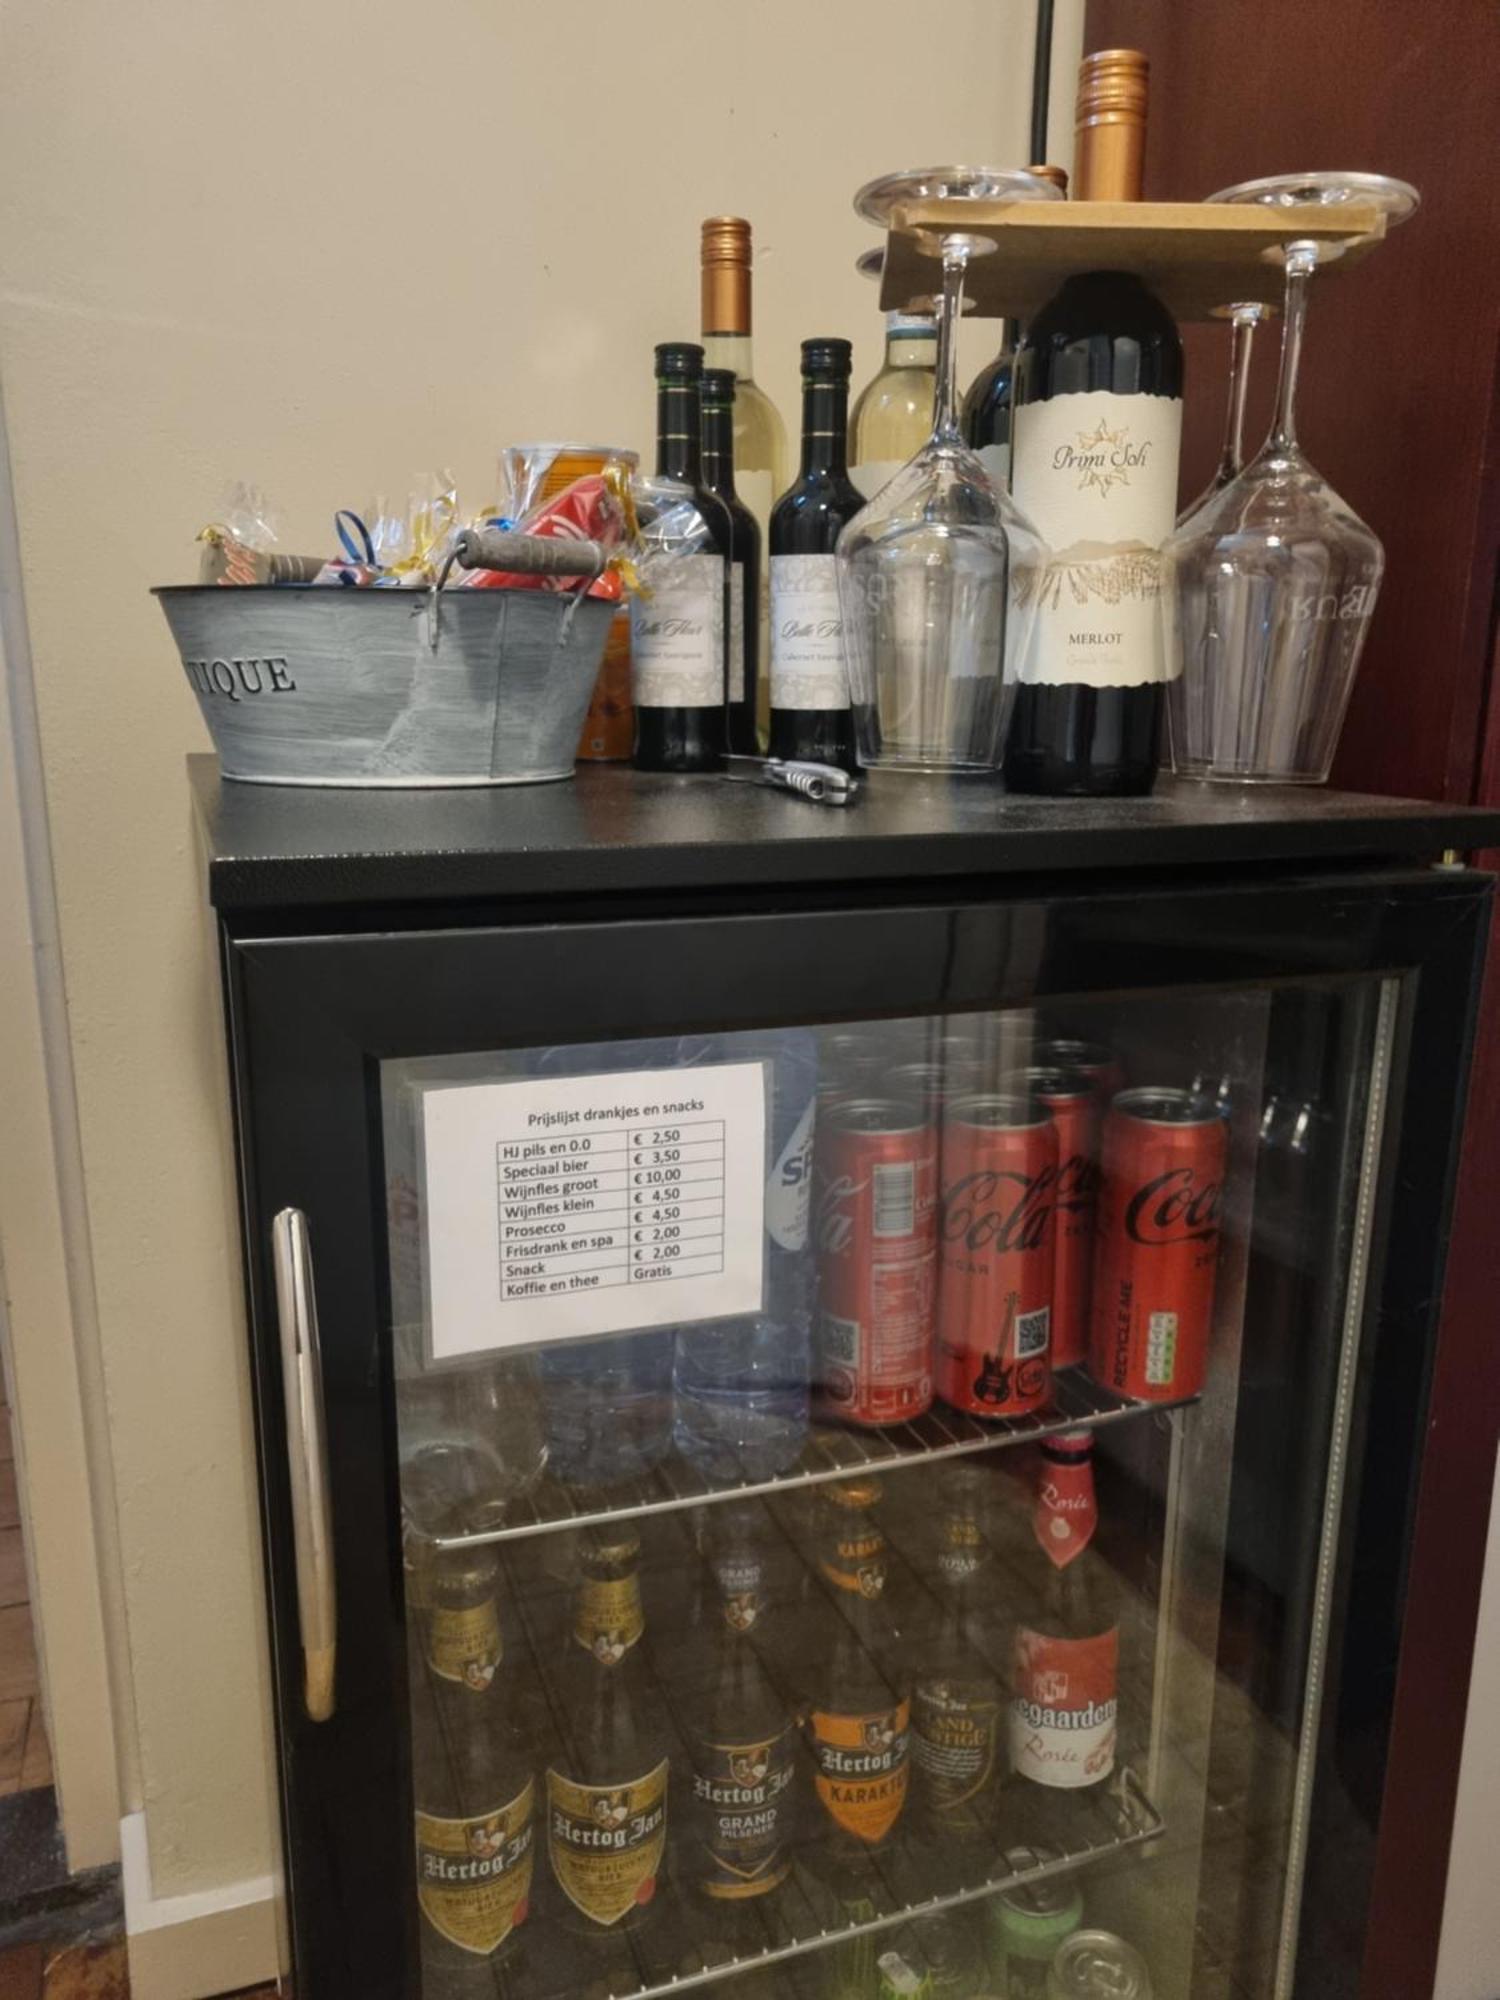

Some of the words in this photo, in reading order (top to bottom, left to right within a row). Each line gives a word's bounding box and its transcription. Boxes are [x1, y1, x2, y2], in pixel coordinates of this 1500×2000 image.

[1069, 633, 1122, 645] MERLOT
[528, 1110, 580, 1128] Prijslijst
[584, 1105, 640, 1120] drankjes
[643, 1105, 660, 1116] en
[663, 1099, 704, 1114] snacks
[503, 1146, 519, 1159] HJ
[523, 1143, 546, 1159] pils
[550, 1143, 566, 1154] en
[569, 1138, 591, 1152] 0.0
[634, 1133, 643, 1145] €
[652, 1129, 680, 1145] 2,50
[503, 1161, 559, 1181] Speciaal
[563, 1160, 589, 1173] bier
[634, 1153, 643, 1165] €
[652, 1149, 680, 1164] 3,50
[504, 1182, 559, 1200] Wijnfles
[562, 1178, 598, 1196] groot
[634, 1172, 643, 1185] €
[646, 1168, 681, 1184] 10,00
[504, 1202, 559, 1220] Wijnfles
[563, 1198, 595, 1212] klein
[634, 1192, 643, 1204] €
[652, 1187, 680, 1203] 4,50
[505, 1222, 566, 1238] Prosecco
[634, 1211, 643, 1223] €
[652, 1207, 680, 1223] 4,50
[506, 1240, 568, 1258] Frisdrank
[571, 1239, 587, 1250] en
[590, 1235, 613, 1251] spa
[634, 1230, 643, 1242] €
[652, 1226, 680, 1241] 2,00
[506, 1262, 545, 1277] Snack
[634, 1249, 643, 1261] €
[652, 1244, 680, 1260] 2,00
[507, 1280, 546, 1296] Koffie
[549, 1280, 566, 1291] en
[569, 1274, 599, 1289] thee
[634, 1264, 672, 1280] Gratis
[819, 1747, 892, 1773] Hertog
[692, 1774, 765, 1804] Hertog
[551, 1811, 627, 1848] Hertog
[628, 1807, 663, 1846] Jan
[718, 1808, 777, 1830] GRAND
[423, 1853, 505, 1880] Hertog
